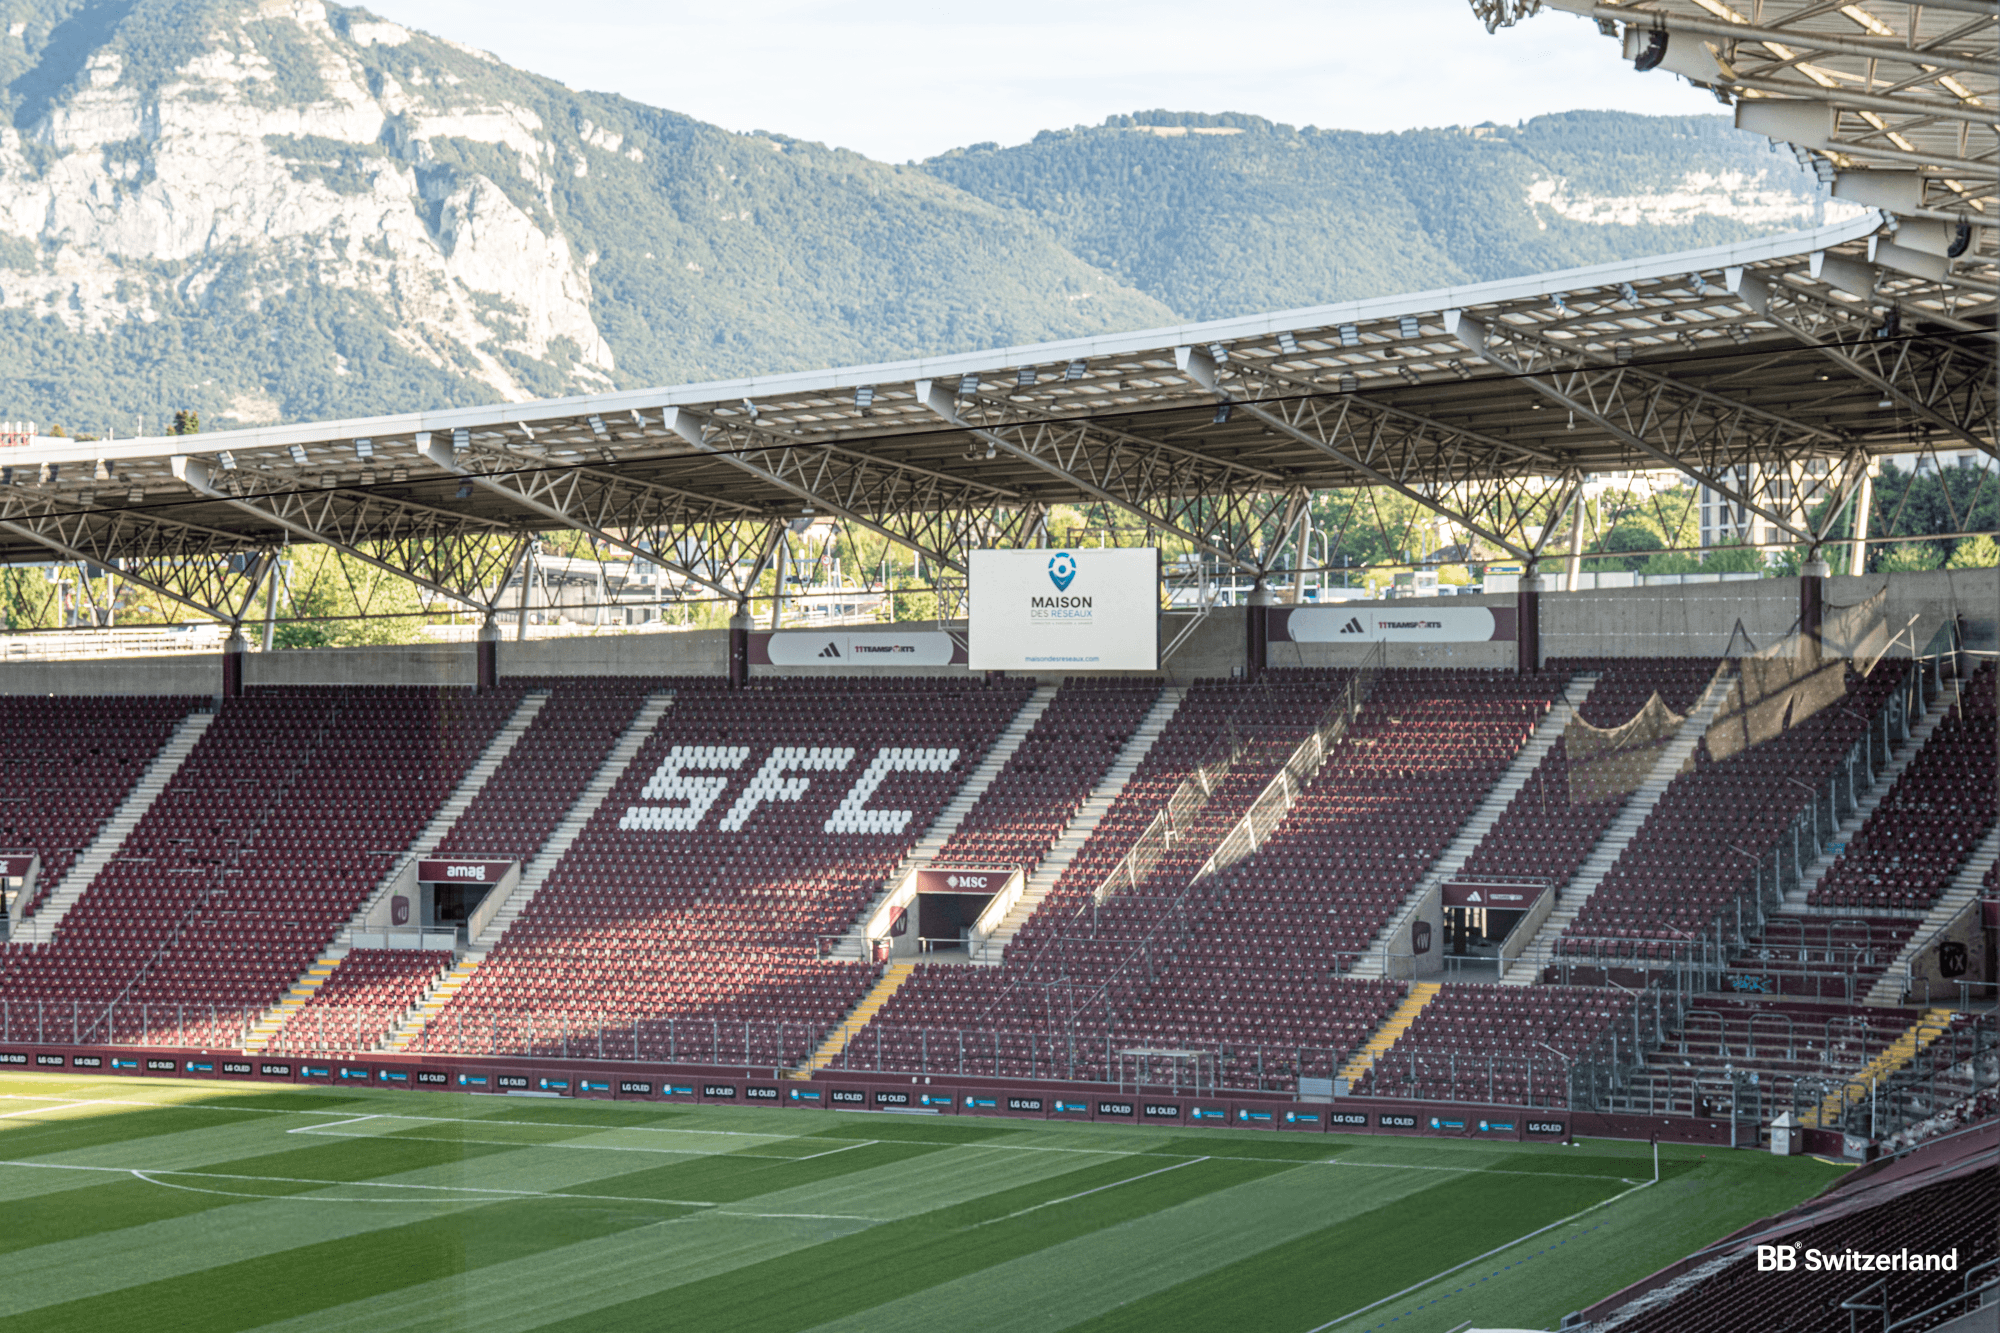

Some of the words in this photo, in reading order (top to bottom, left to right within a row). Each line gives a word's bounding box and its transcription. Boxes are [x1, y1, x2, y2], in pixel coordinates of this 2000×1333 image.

[1031, 596, 1092, 608] MAISON
[1031, 609, 1049, 618] DES
[619, 745, 960, 834] SFC
[447, 865, 486, 881] amag
[959, 876, 988, 888] MSC
[1021, 1101, 1040, 1109] OLED
[1112, 1105, 1130, 1113] OLED
[1158, 1107, 1177, 1115] OLED
